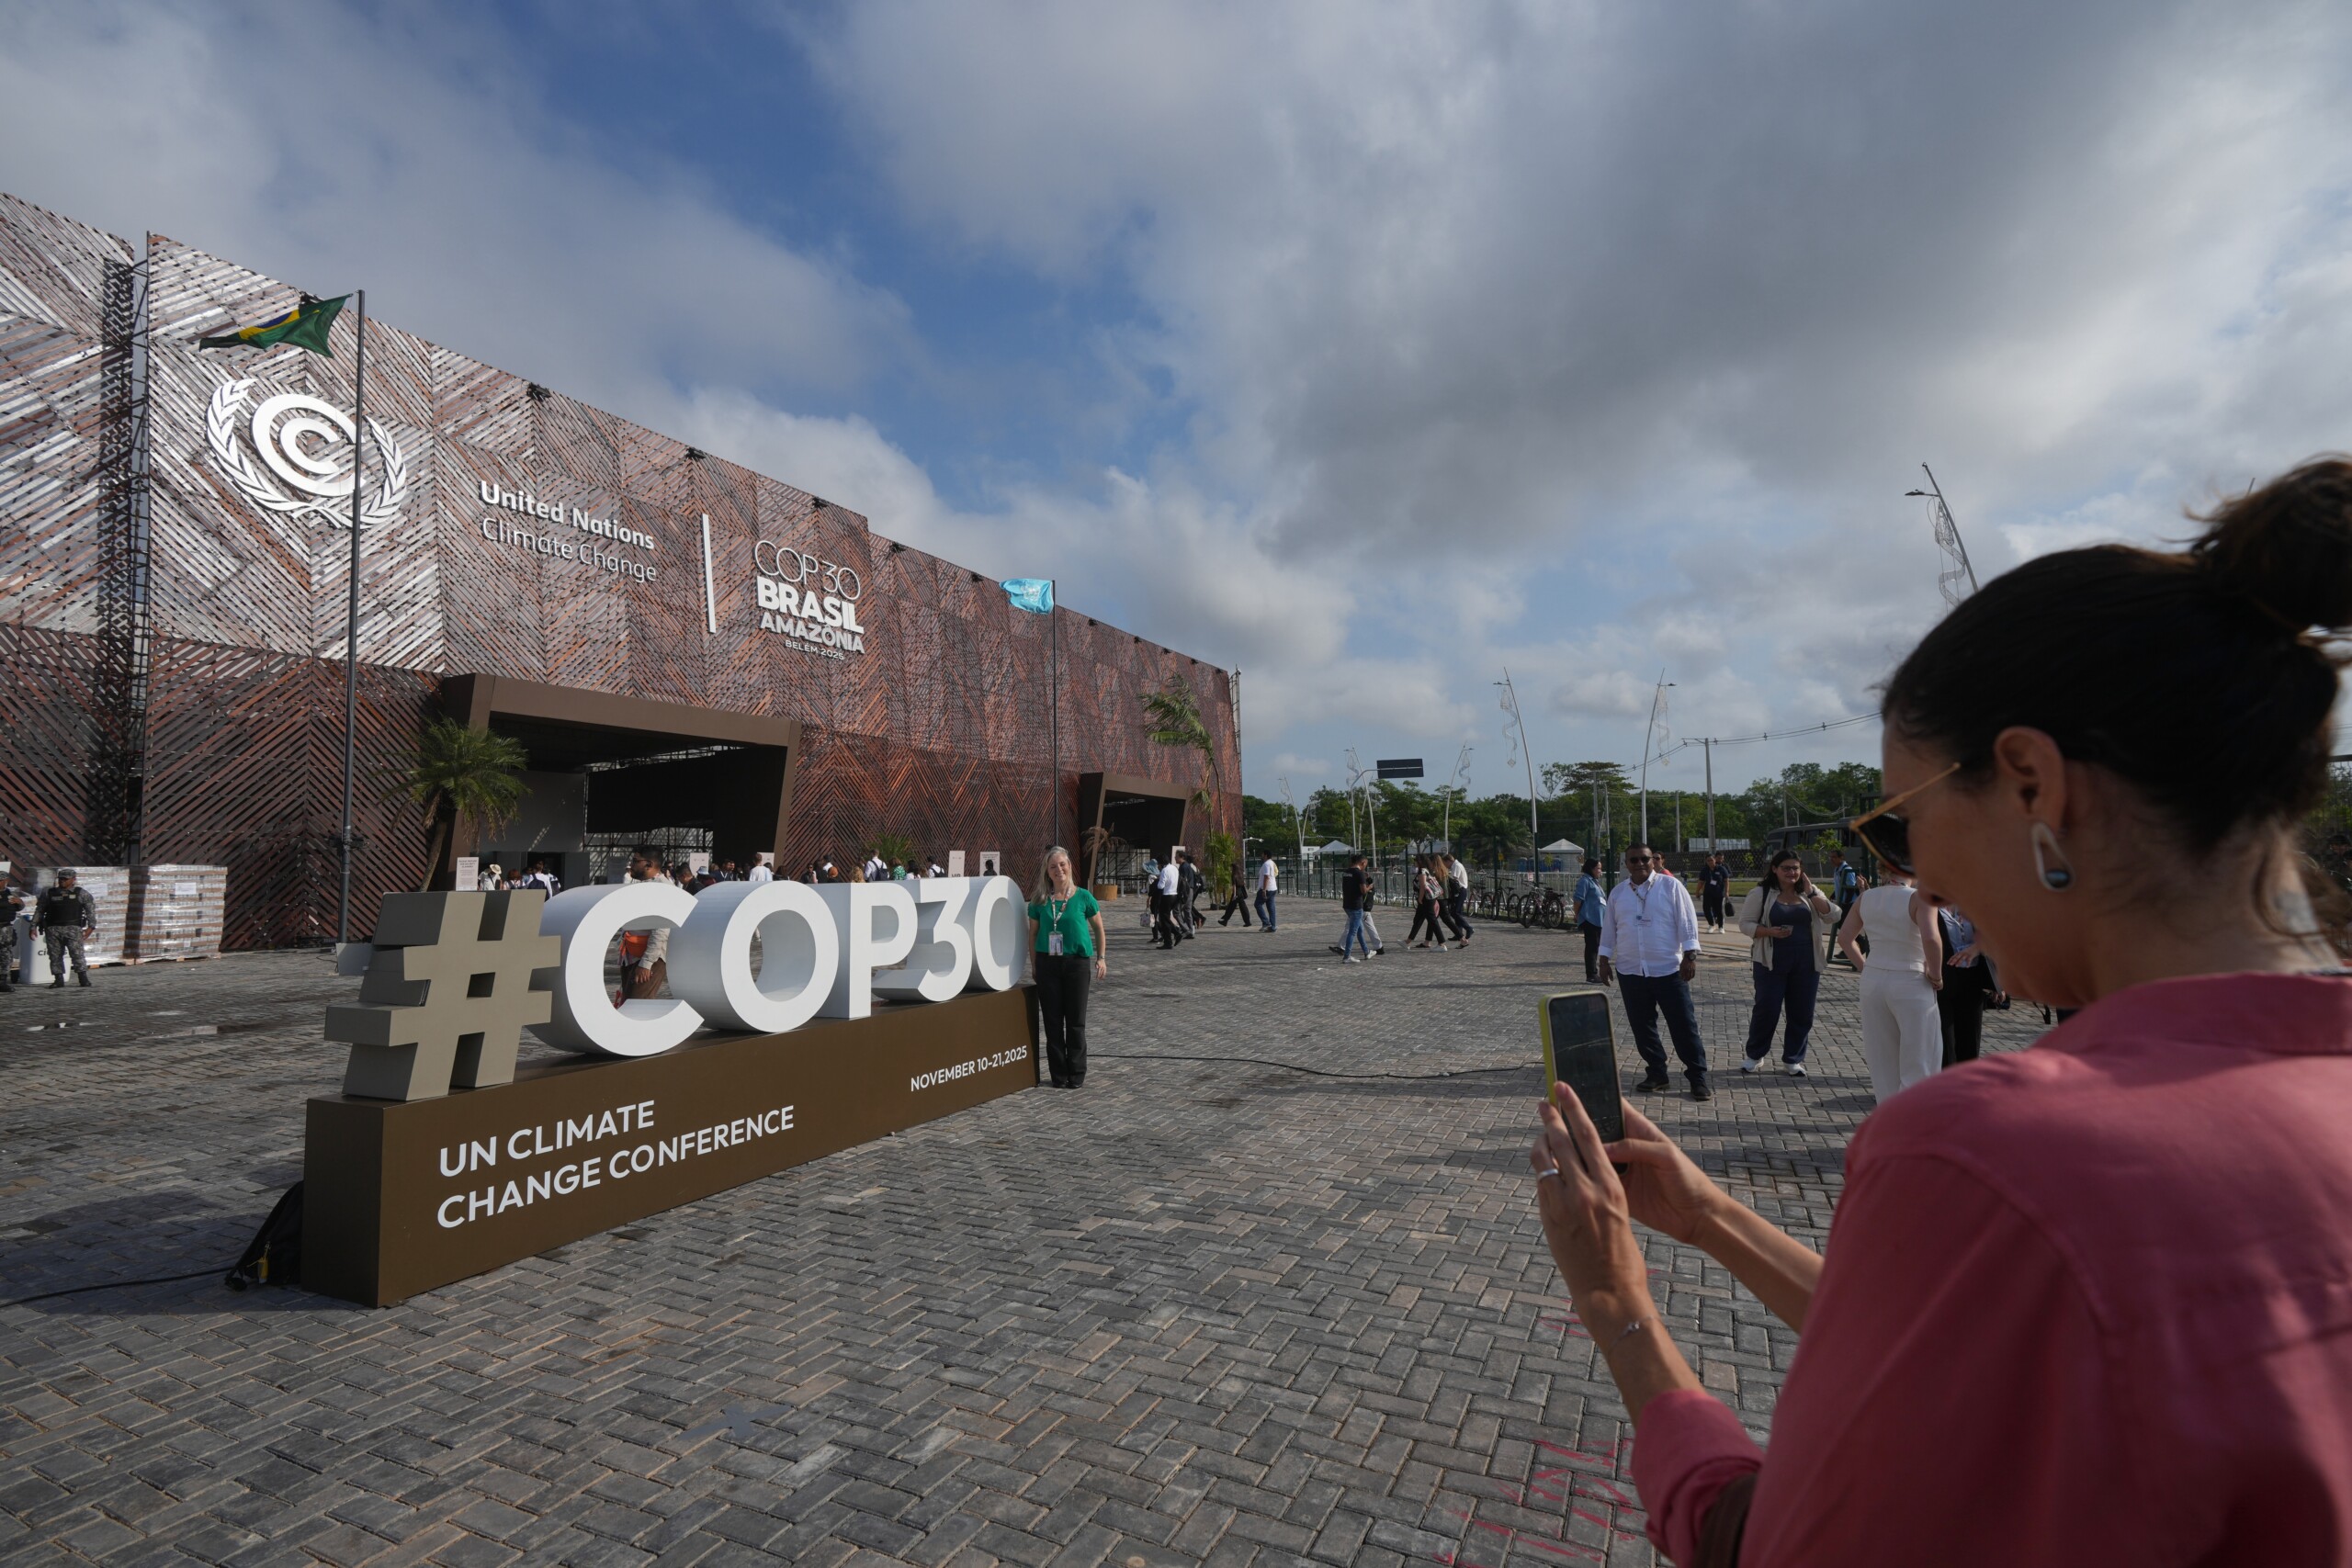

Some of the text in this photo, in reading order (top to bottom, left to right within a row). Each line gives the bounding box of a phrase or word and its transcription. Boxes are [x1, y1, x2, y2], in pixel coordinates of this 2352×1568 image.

[480, 480, 655, 549] United Nations
[481, 517, 657, 583] Climate Change
[757, 575, 865, 634] BRASIL
[760, 611, 865, 654] AMAZÔNIA
[785, 639, 844, 660] BELÉM 2025
[386, 875, 1028, 1100] #COP30
[910, 1060, 975, 1091] NOVEMBER
[436, 1104, 795, 1229] CHANGE CONFERENCE
[439, 1100, 656, 1177] UN CLIMATE
